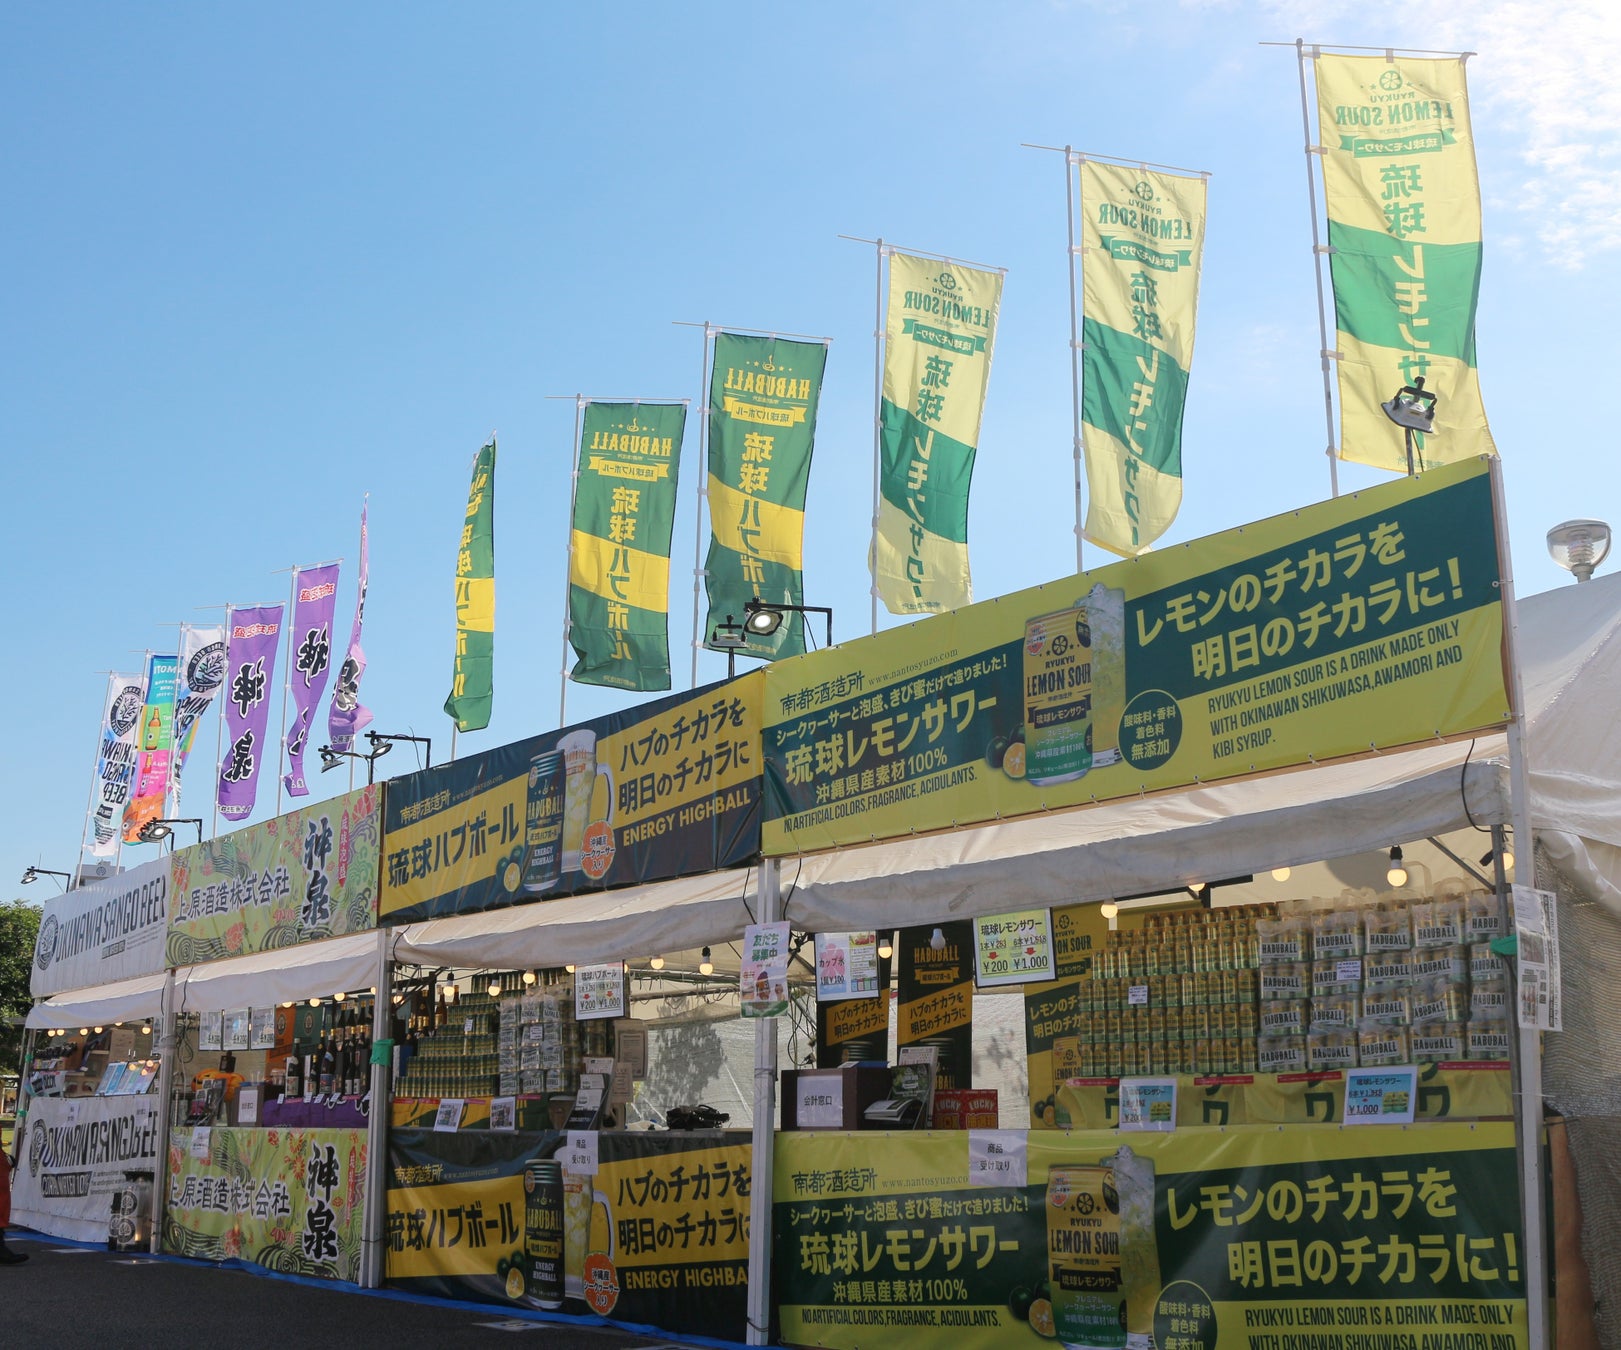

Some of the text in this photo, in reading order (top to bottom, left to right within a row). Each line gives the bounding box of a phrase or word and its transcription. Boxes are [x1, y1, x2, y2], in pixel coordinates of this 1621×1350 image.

[1136, 520, 1406, 648] レモンのチカラを
[1045, 656, 1076, 670] RYUKYU
[1208, 618, 1461, 714] RYUKYU LEMON SOUR IS A DRINK MADE ONLY
[1027, 663, 1092, 699] LEMON SOUR
[1210, 714, 1239, 737] WITH
[1240, 696, 1301, 729] OKINAWAN
[1436, 644, 1464, 668] AND
[780, 670, 866, 716] 南都酒造所
[619, 696, 747, 772] ハブのチカラを
[784, 689, 998, 787] 琉球レモンサワー
[1135, 722, 1166, 740] 着色料
[1130, 738, 1171, 762] 無添加
[1212, 726, 1277, 760] KIBI SYRUP.
[619, 739, 751, 816] 明日のチカラに
[792, 805, 835, 831] ARTIFICIAL
[919, 765, 978, 796] ACIDULANTS.
[623, 787, 752, 847] ENERGY HIGHBALL
[388, 802, 520, 889] 琉球ハブボール
[302, 816, 334, 927] 神泉
[174, 867, 290, 924] 上原酒造株式会社
[56, 906, 103, 963] OKINAWA
[101, 887, 140, 944] SANGO
[139, 874, 166, 929] BEER
[981, 919, 1043, 936] 琉球レモンサワー
[752, 932, 780, 947] 友だち
[1316, 934, 1353, 948] HABUBALL
[1370, 933, 1408, 946] HABUBALL
[1417, 926, 1457, 941] HABUBALL
[983, 960, 1009, 973] ¥200
[1369, 964, 1410, 978] HABUBALL
[1413, 958, 1452, 976] HABUBALL
[1263, 976, 1300, 988] HABUBALL
[910, 991, 964, 1020] ハブのチカラを
[1366, 1001, 1404, 1016] HABUBALL
[910, 1008, 967, 1035] 明日のチカラに
[1311, 1046, 1351, 1059] HABUBALL
[1361, 1041, 1398, 1057] HABUBALL
[1413, 1036, 1454, 1050] HABUBALL
[1260, 1050, 1297, 1063] HABUBALL
[1348, 1104, 1379, 1115] ¥1,000
[987, 1143, 1004, 1154] 商品
[979, 1160, 1011, 1172] 受け取り
[618, 1161, 752, 1207] ハブのチカラを
[791, 1167, 878, 1196] 南都酒造所
[881, 1173, 969, 1189] www.nantosyuzo.co
[168, 1175, 291, 1218] 上原酒造株式会社
[304, 1142, 339, 1260] 神泉
[1167, 1166, 1458, 1232] レモンのチカラを
[386, 1200, 520, 1252] 琉球ハブボール
[1070, 1217, 1102, 1228] RYUKYU
[800, 1225, 1020, 1277] 琉球レモンサワー
[1051, 1229, 1120, 1256] LEMON SOUR
[532, 1271, 558, 1282] HIGHBALL
[535, 1261, 556, 1271] ENERGY
[626, 1269, 681, 1290] ENERGY
[1062, 1274, 1116, 1289] 琉球レモンサワー
[812, 1309, 852, 1327] ARTIFICIAL
[940, 1311, 1002, 1328] ACIDULANTS.
[1245, 1304, 1514, 1327] RYUKYU LEMON SOUR IS A DRINK MADE ONLY
[1170, 1319, 1199, 1335] 着色料
[1248, 1334, 1281, 1350] WITH
[1282, 1334, 1344, 1350] OKINAWAN
[1490, 1333, 1517, 1350] AND
